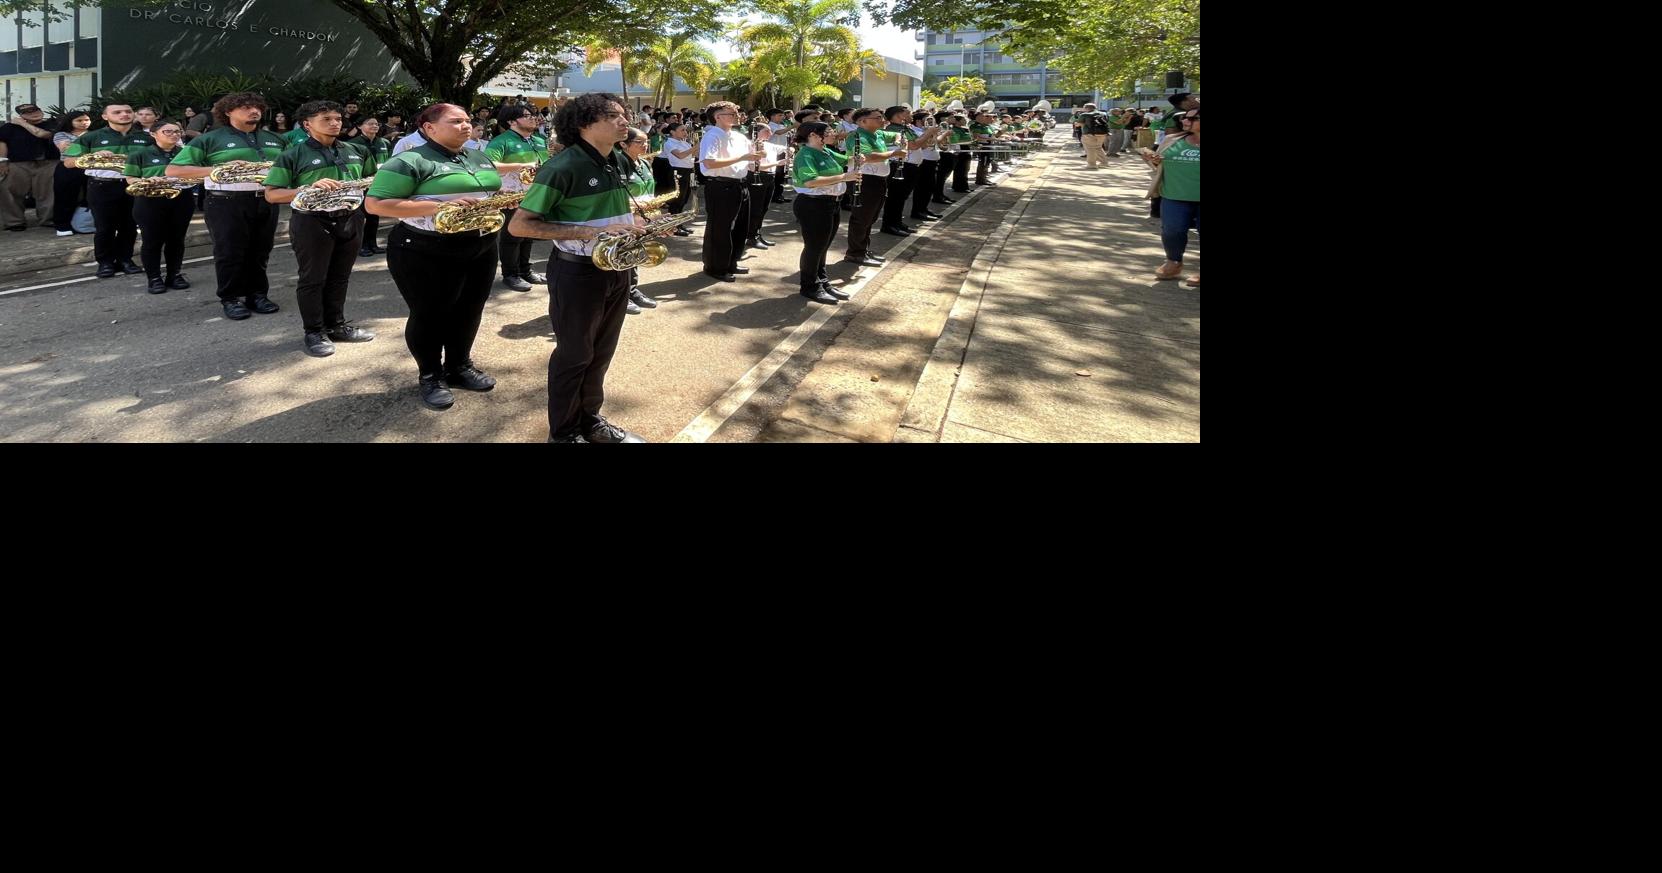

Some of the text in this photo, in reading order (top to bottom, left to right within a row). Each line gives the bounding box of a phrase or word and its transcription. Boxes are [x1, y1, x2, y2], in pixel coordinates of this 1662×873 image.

[169, 13, 238, 30] CARLOS
[250, 24, 258, 33] E
[269, 26, 335, 42] CHARDON
